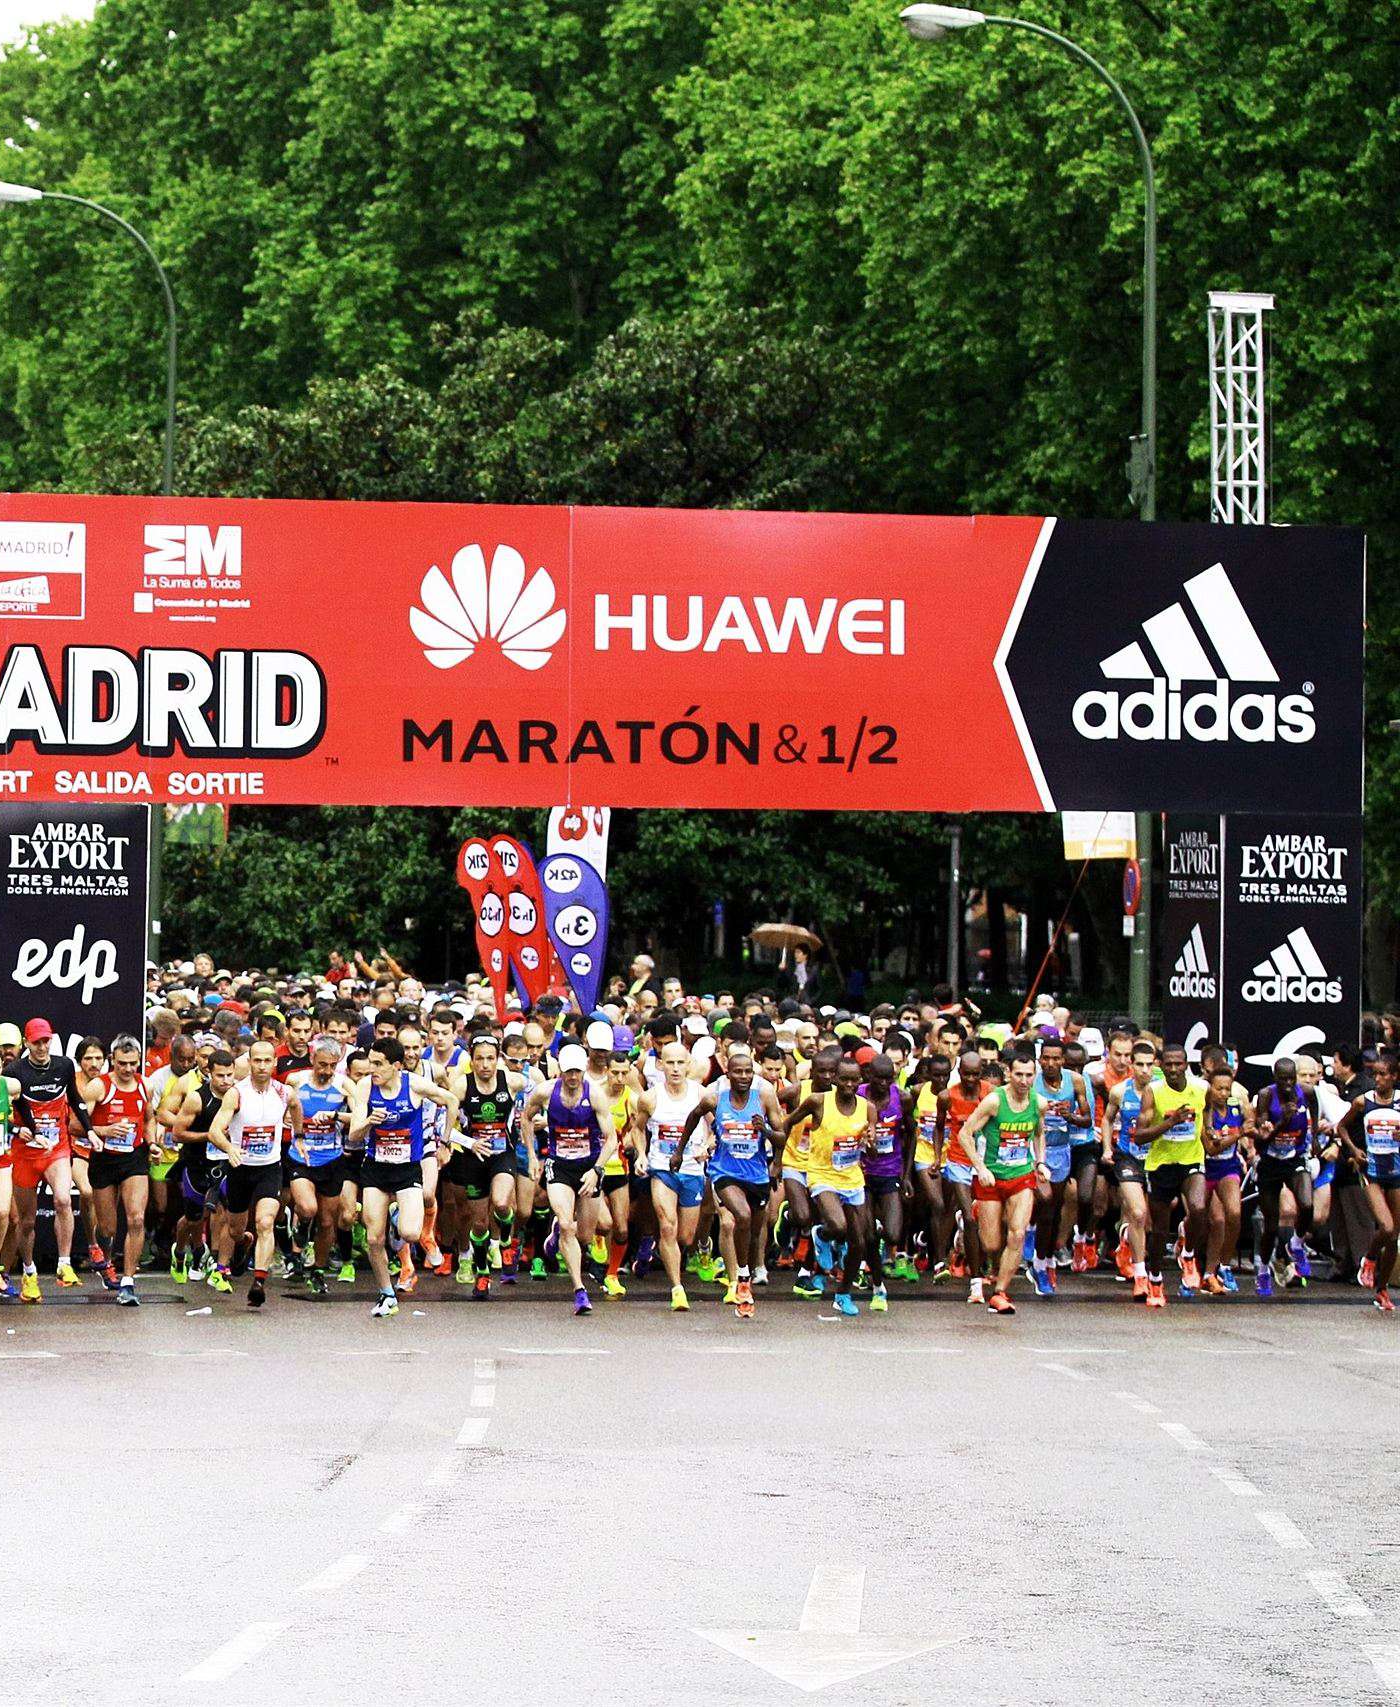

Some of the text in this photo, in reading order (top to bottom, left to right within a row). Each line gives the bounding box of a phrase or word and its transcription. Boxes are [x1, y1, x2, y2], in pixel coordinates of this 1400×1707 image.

[143, 576, 241, 590] La Suma de Todos
[594, 594, 906, 656] HUAWEI
[1072, 676, 1316, 745] adidas
[403, 705, 899, 772] MARATÓN & 1/2
[54, 770, 153, 797] SALIDA
[167, 772, 264, 797] SORTIE
[32, 822, 106, 842] AMBAR
[1178, 831, 1209, 848] AMBAR
[1261, 834, 1326, 852] AMBAR
[9, 834, 130, 871] EXPORT
[1169, 843, 1219, 875] EXPORT
[1240, 846, 1348, 880] EXPORT
[7, 874, 129, 888] TRES MALTAS
[7, 886, 129, 897] DOBLE FERMENTACIÓN
[1169, 880, 1219, 892] TRES MALTAS
[1239, 882, 1348, 897] TRES MALTAS
[1239, 895, 1348, 905] DOBLE FERMENTACIÓN
[11, 923, 120, 1005] edp
[1169, 972, 1217, 1000] adidas
[1241, 975, 1343, 1004] adidas
